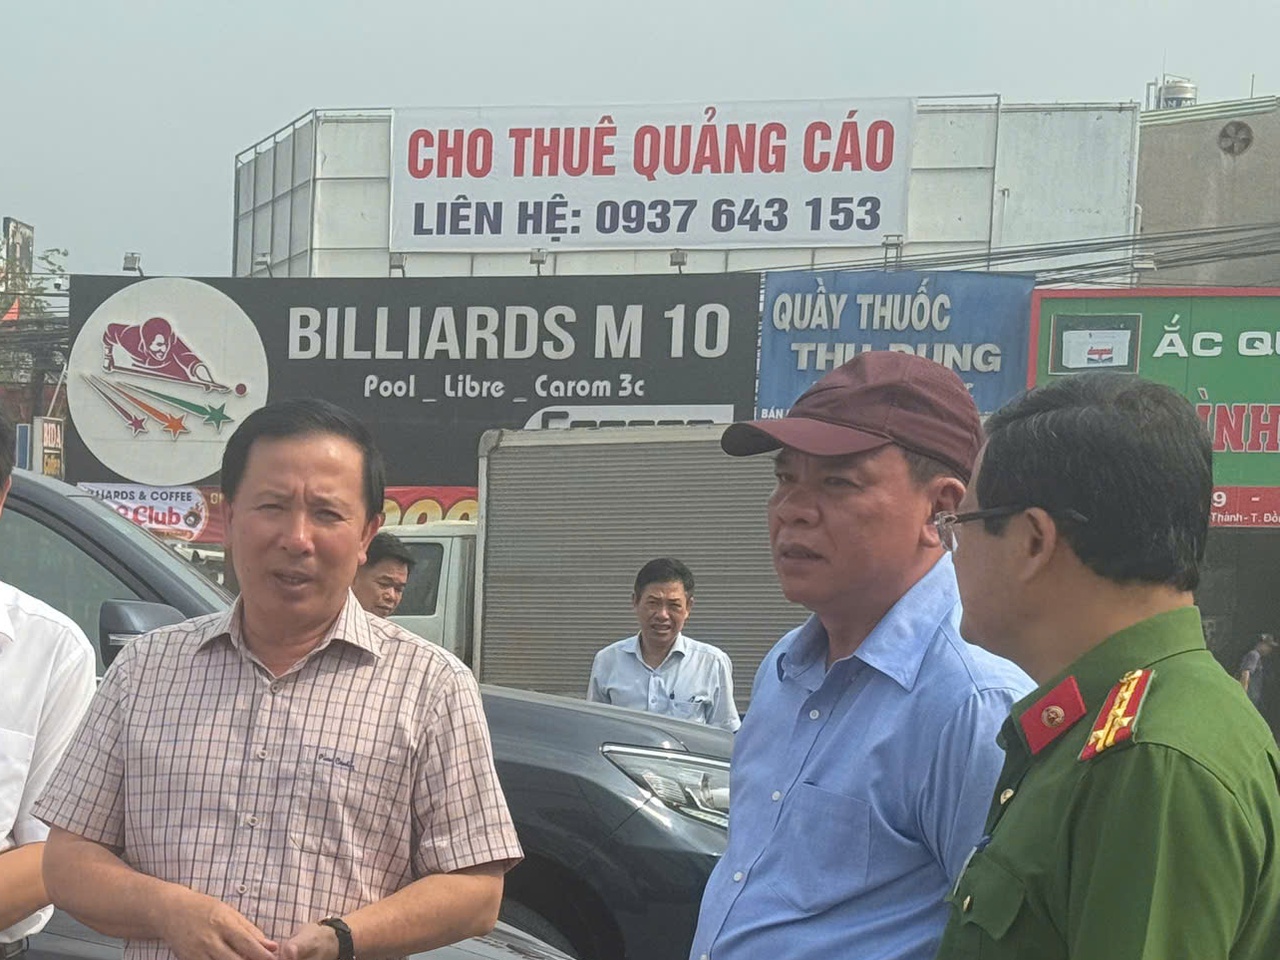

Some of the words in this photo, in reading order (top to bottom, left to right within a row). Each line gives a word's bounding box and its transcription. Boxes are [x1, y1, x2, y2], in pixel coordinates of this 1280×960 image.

[407, 127, 494, 179] CHO
[509, 114, 618, 177] THUÊ
[632, 106, 787, 181] QUẢNG
[802, 110, 896, 173] CÁO
[413, 195, 503, 236] LIÊN
[516, 193, 582, 242] HỆ:
[595, 198, 698, 234] 0937
[711, 198, 789, 233] 643
[804, 197, 881, 231] 153
[773, 277, 848, 332] QUẦY
[856, 277, 951, 331] THUỐC
[287, 306, 577, 360] BILLIARDS
[594, 304, 644, 359] M
[663, 303, 731, 359] 10
[1152, 313, 1223, 358] ẮC
[1237, 331, 1280, 357] Q
[889, 343, 1003, 372] UNG
[364, 374, 416, 398] Pool
[444, 374, 505, 398] Libre
[534, 374, 612, 398] Carom
[618, 373, 645, 397] 3c
[761, 405, 784, 419] BÁN
[138, 491, 147, 501] &
[150, 491, 192, 502] COFFEE
[132, 505, 181, 526] Club
